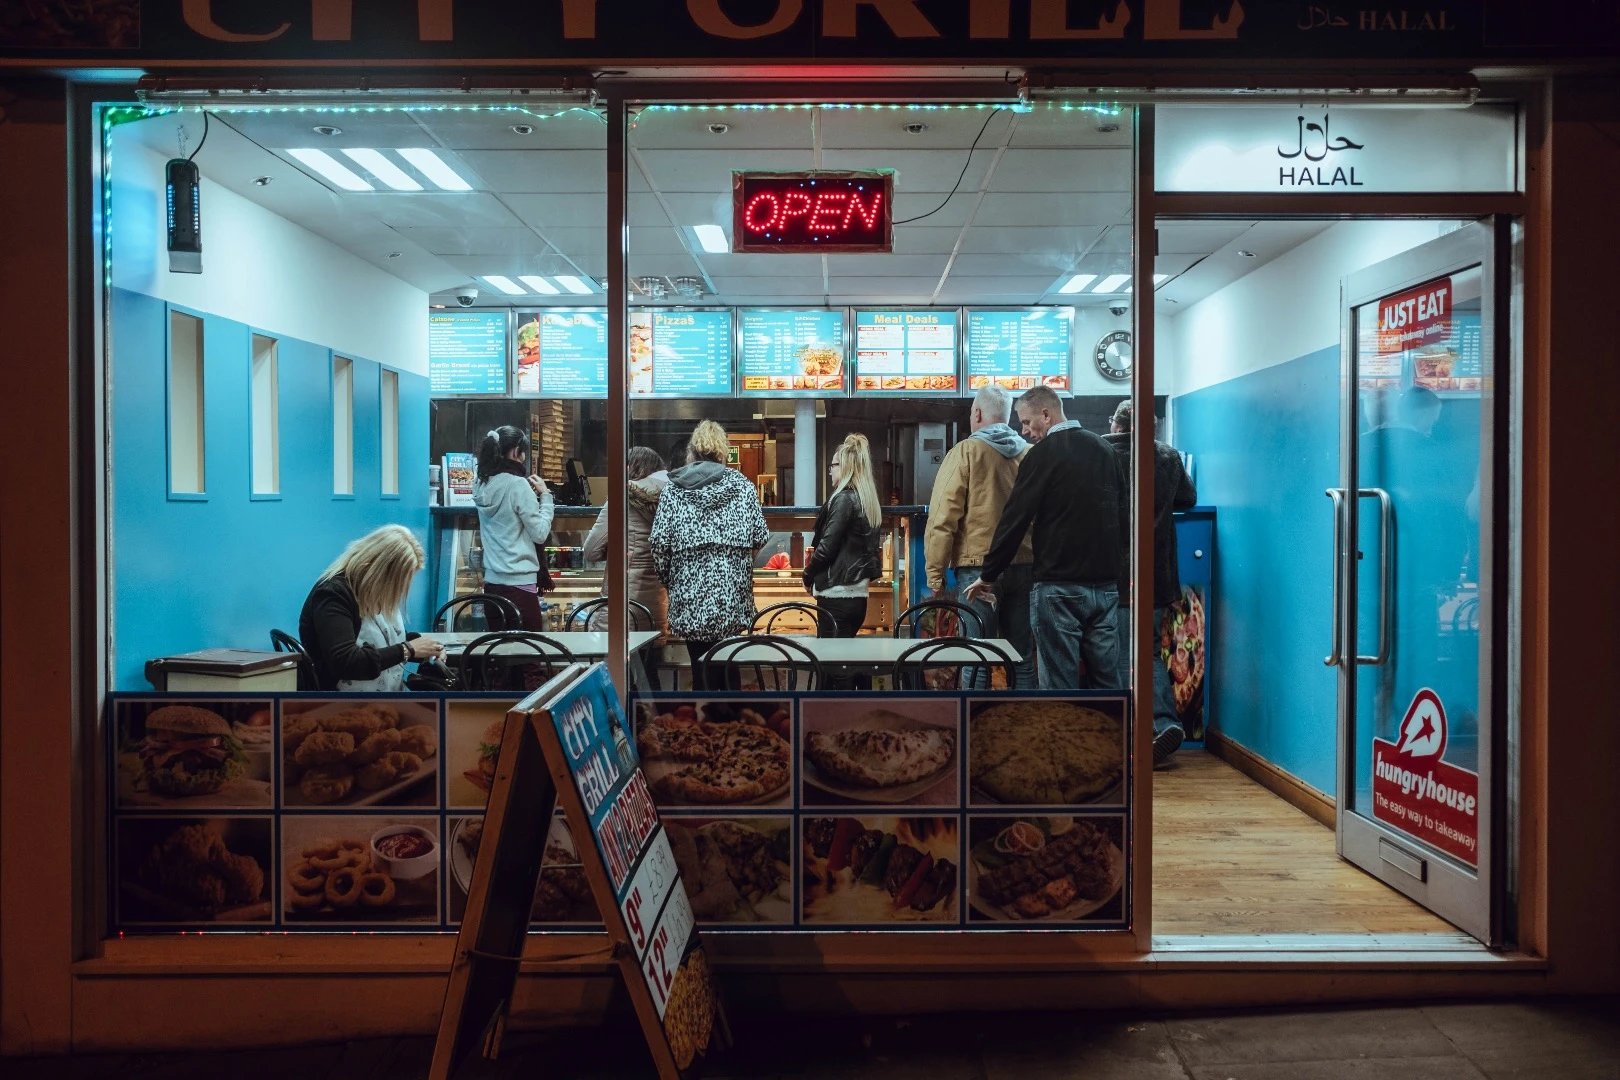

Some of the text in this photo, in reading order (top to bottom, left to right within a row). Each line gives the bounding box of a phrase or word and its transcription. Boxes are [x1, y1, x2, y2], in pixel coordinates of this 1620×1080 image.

[1358, 10, 1455, 31] HALAL
[1277, 112, 1365, 162] حلال
[1279, 166, 1364, 186] HALAL
[744, 192, 883, 232] OPEN
[655, 315, 695, 326] Pizzas
[874, 314, 938, 324] Meal Deals
[1381, 288, 1448, 331] JUST EAT
[562, 697, 599, 761] CITY
[576, 744, 620, 816] GRILL
[1376, 751, 1476, 816] hungryhouse
[597, 808, 630, 896] ANY
[617, 766, 658, 857] PIZZAS
[1375, 791, 1476, 852] The easy way to takeaway
